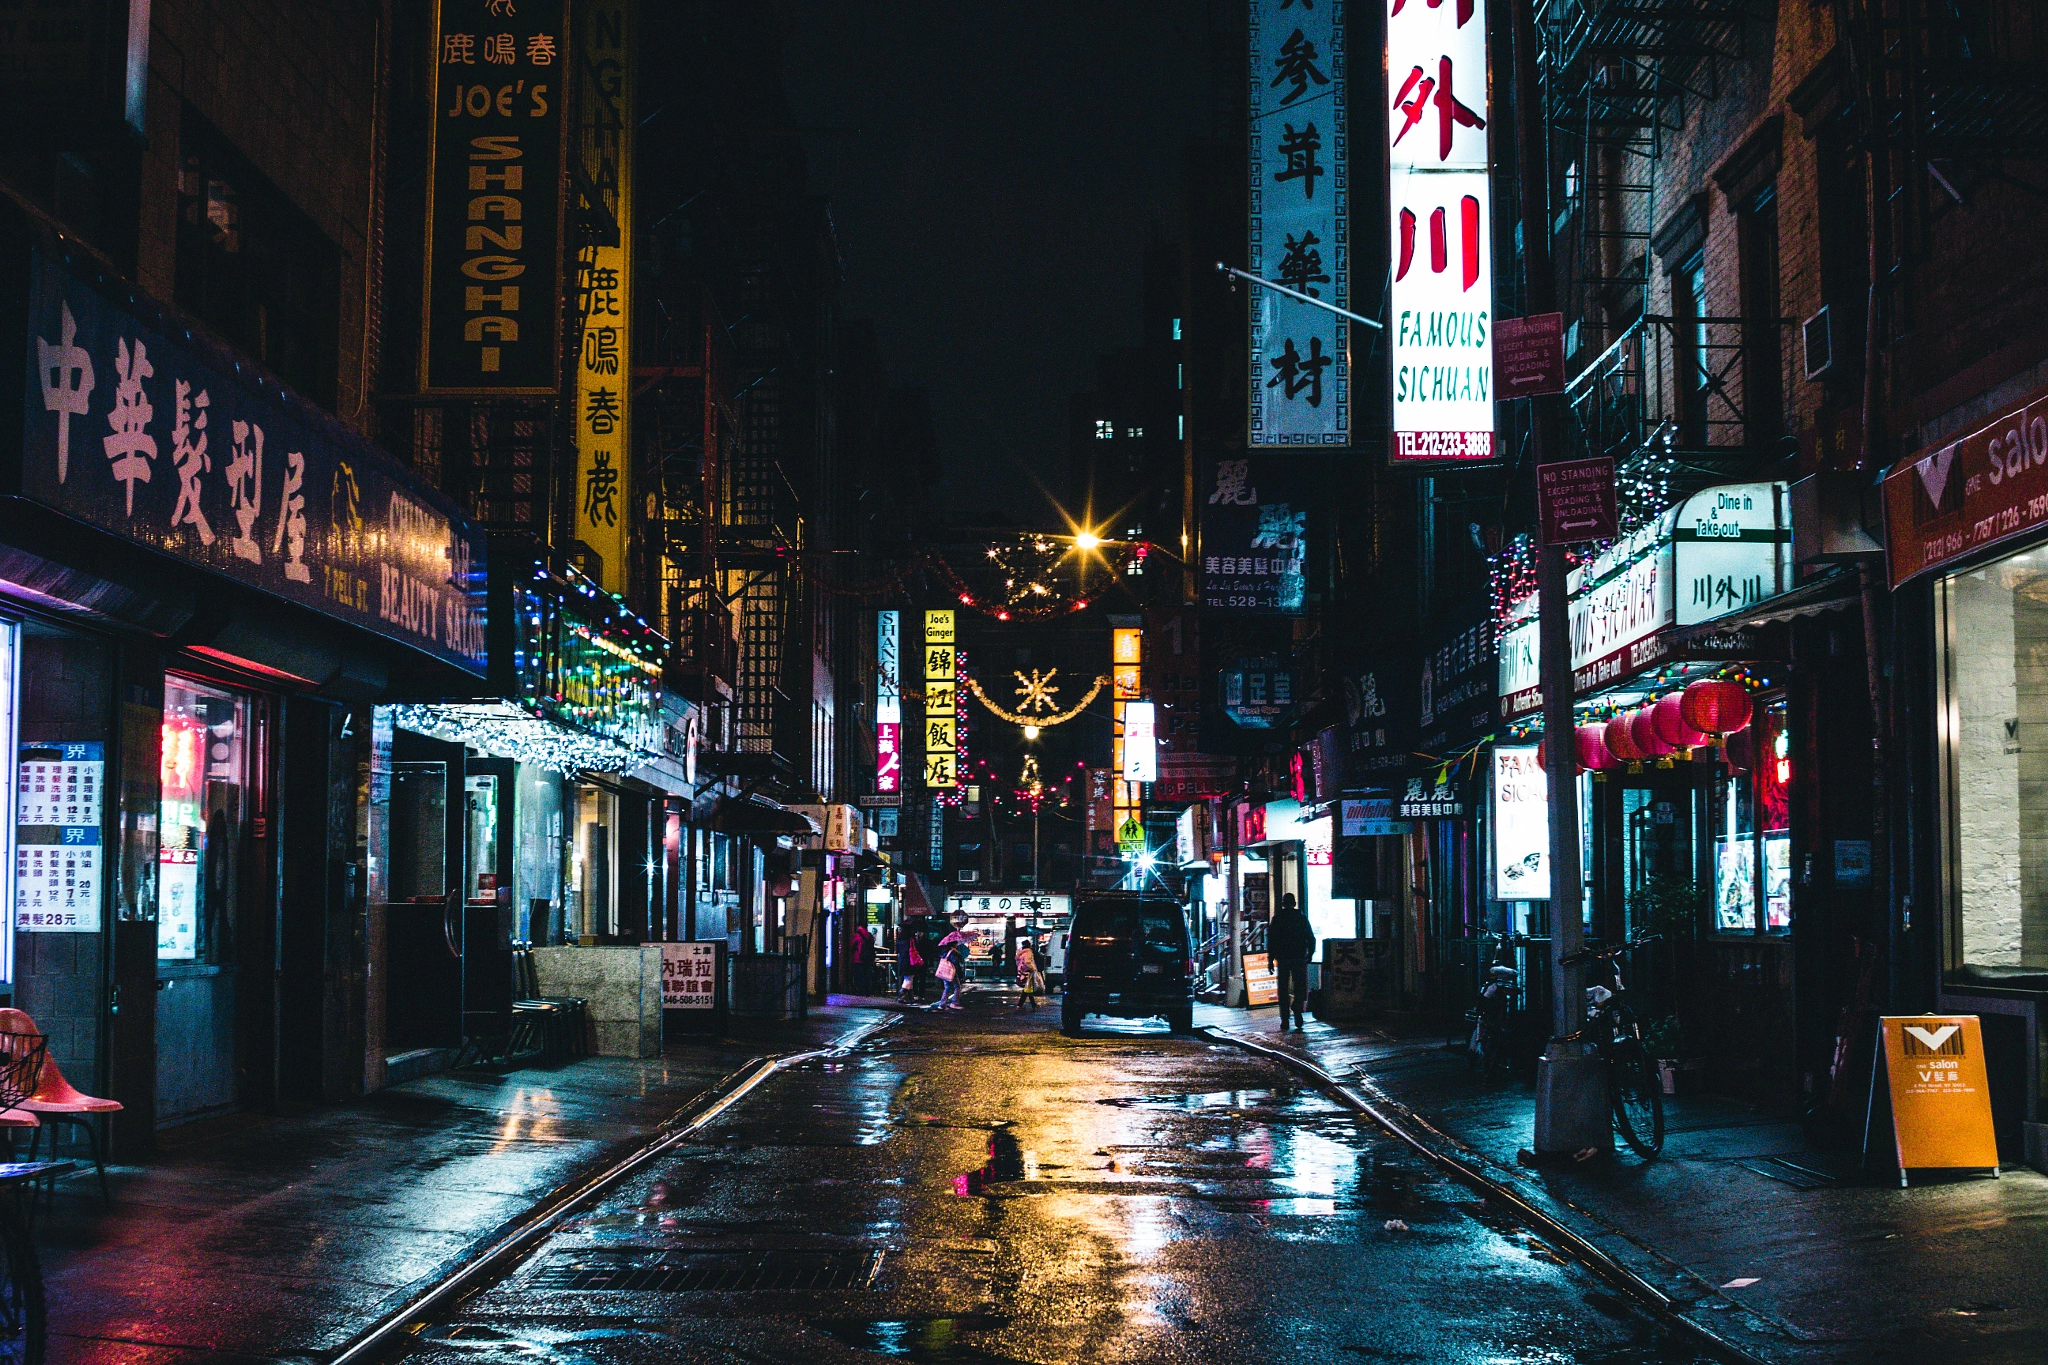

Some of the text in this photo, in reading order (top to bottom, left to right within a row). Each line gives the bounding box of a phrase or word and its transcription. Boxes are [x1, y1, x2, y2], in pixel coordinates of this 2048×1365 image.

[442, 33, 557, 66] 鹿鳴春
[449, 79, 549, 118] JOE'S
[460, 135, 526, 373] SHANGHAI
[1399, 311, 1488, 348] FAMOUS
[1511, 321, 1557, 337] STANDING
[1499, 341, 1525, 353] EXCEPT
[1504, 351, 1539, 363] LOADING
[1504, 360, 1550, 374] UNLOADING
[1397, 366, 1489, 402] SICHUAN
[1543, 466, 1608, 482] NO STANDING
[1547, 482, 1606, 496] EXCEPT TRUCKS
[1552, 496, 1590, 507] LOADING
[1717, 493, 1753, 510] Dine in
[1553, 505, 1603, 518] UNLOADING
[1711, 507, 1718, 519] &
[1696, 518, 1740, 536] Take out
[1946, 530, 1963, 553] 966
[1972, 515, 1995, 541] 7767
[2001, 506, 2019, 531] 226
[2028, 493, 2048, 520] 769
[1693, 574, 1760, 610] 川外川
[380, 562, 485, 661] BEAUTY SALON
[930, 613, 950, 624] Joe's
[926, 626, 953, 639] Ginger
[1598, 659, 1610, 683] Take
[1611, 653, 1621, 677] out
[927, 649, 955, 785] 錦江飯店
[878, 724, 899, 790] 上海人家
[1178, 782, 1210, 795] PELL
[1929, 1060, 1958, 1069] salon
[1918, 1071, 1931, 1082] V
